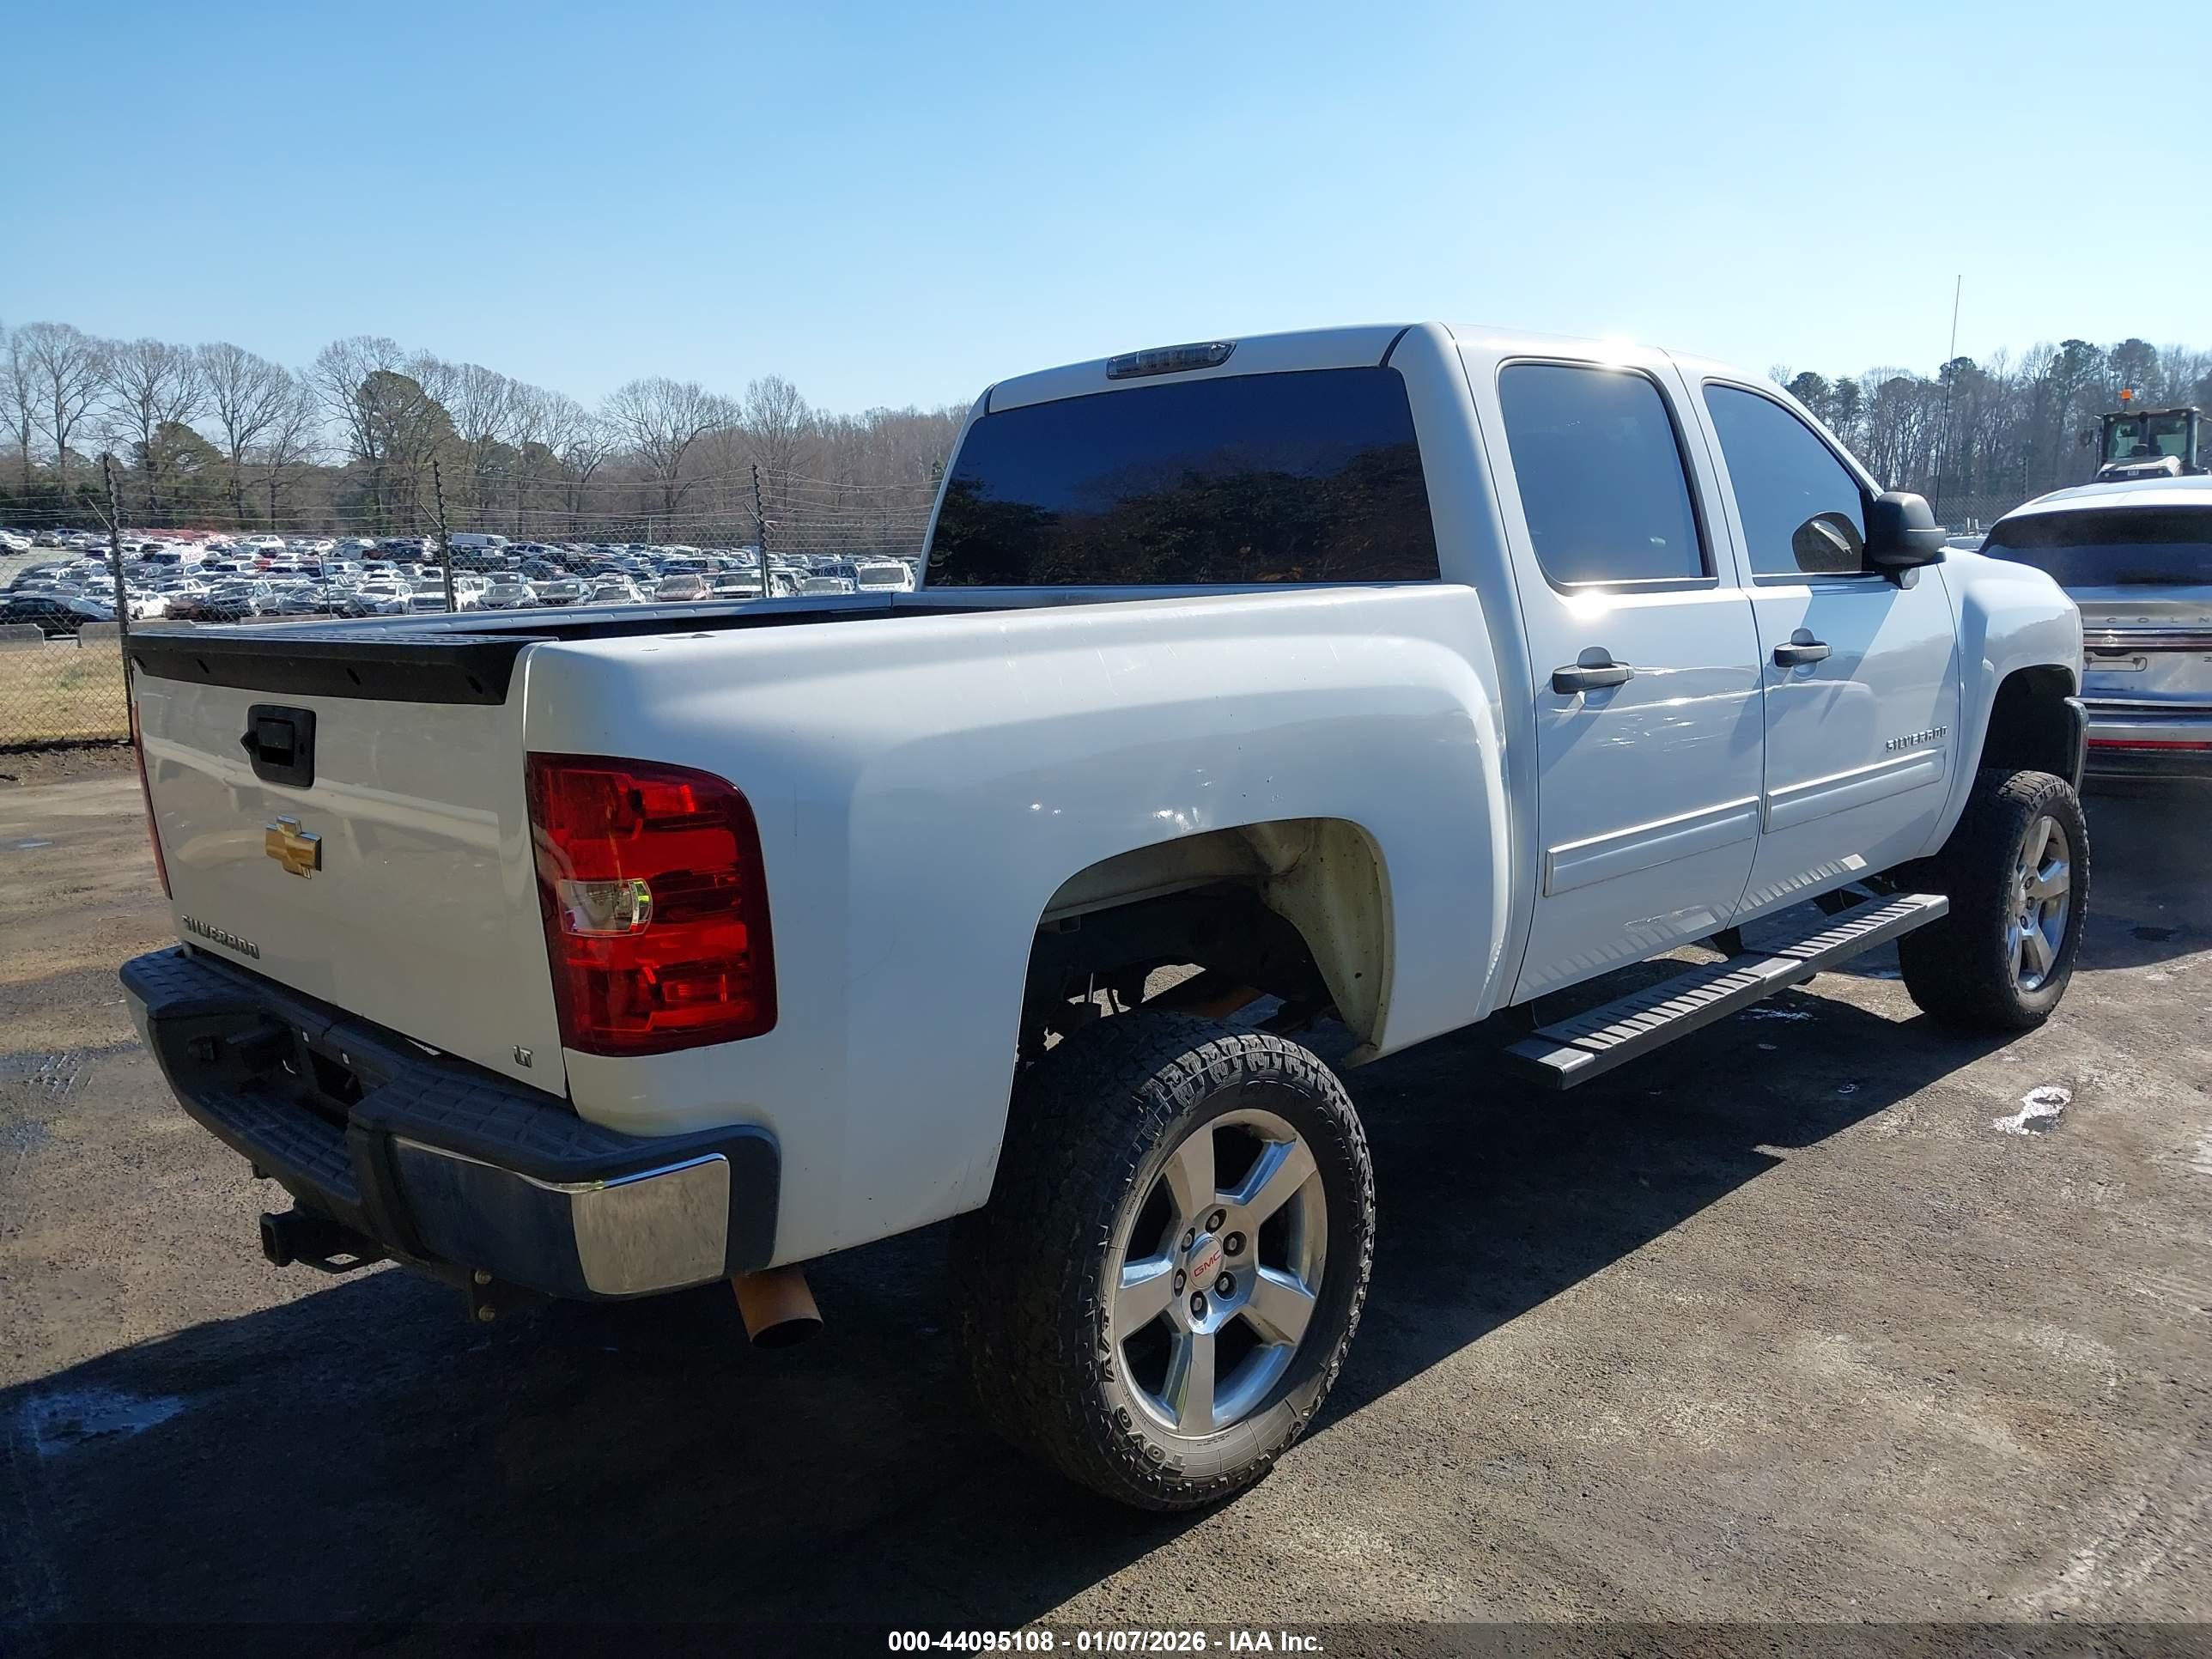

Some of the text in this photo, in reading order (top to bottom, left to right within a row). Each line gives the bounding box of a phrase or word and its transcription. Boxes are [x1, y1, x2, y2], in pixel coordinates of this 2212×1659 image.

[1885, 725, 1948, 753] SILVERADO
[182, 915, 260, 960] SILVERADO
[514, 1044, 533, 1068] LT
[1194, 1249, 1221, 1278] GMC
